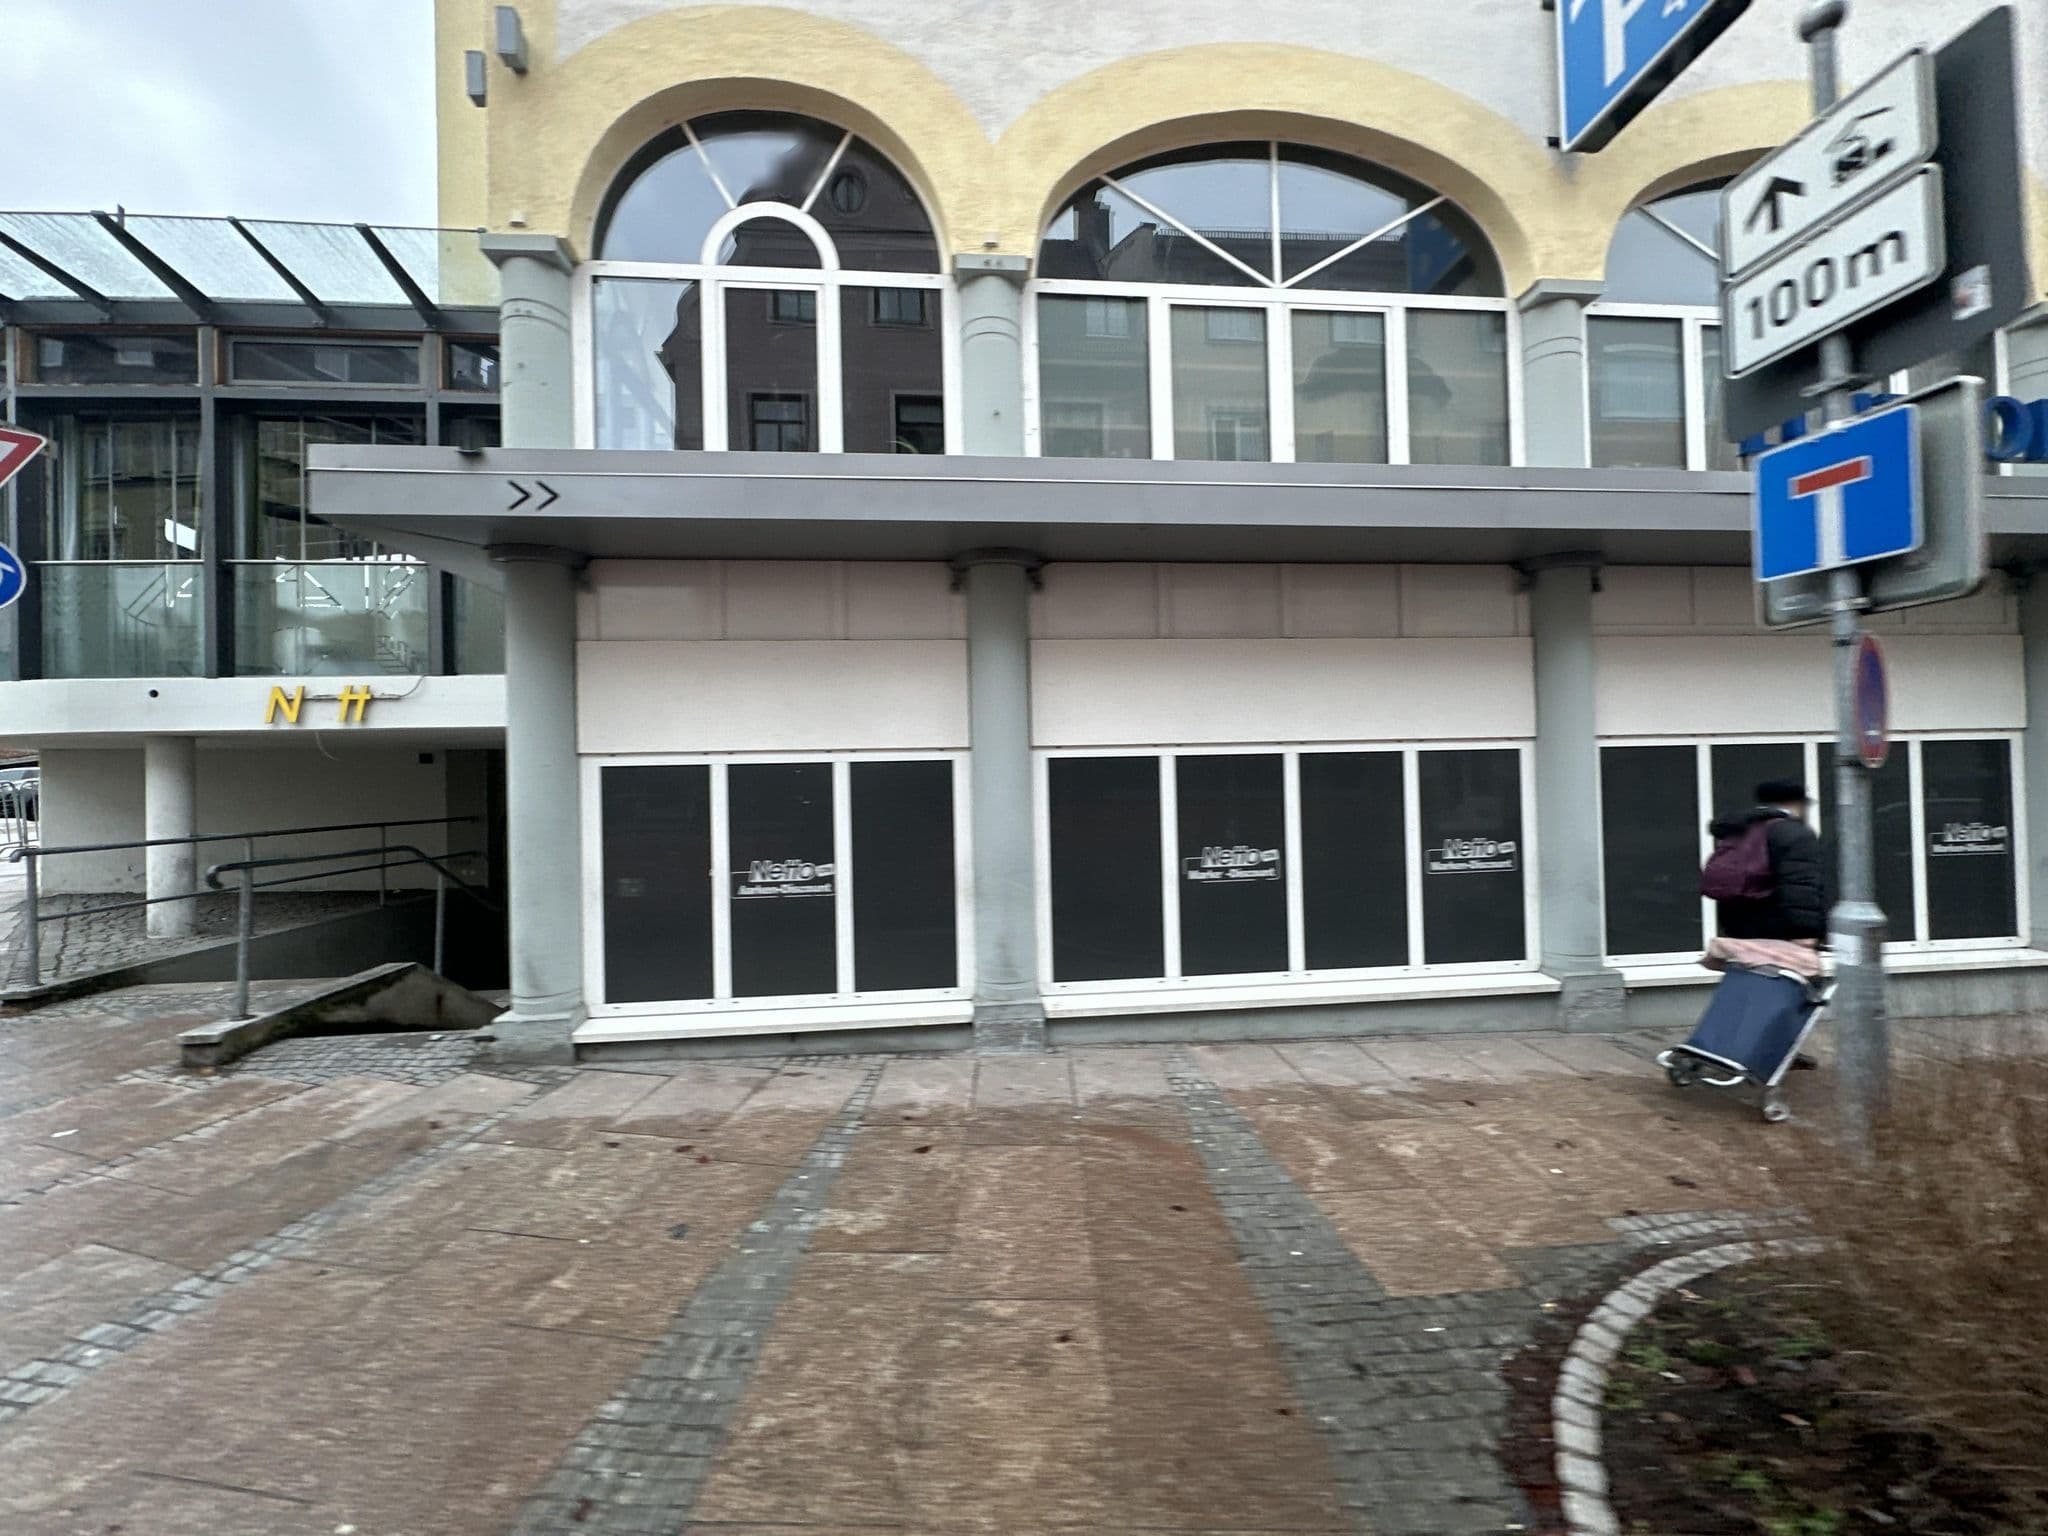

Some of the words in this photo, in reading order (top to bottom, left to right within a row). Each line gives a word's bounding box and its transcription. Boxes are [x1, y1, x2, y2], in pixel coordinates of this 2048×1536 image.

[1747, 231, 1907, 340] 100m
[1200, 845, 1261, 868] Netto
[1440, 837, 1499, 860] Netto
[748, 859, 816, 882] Netto
